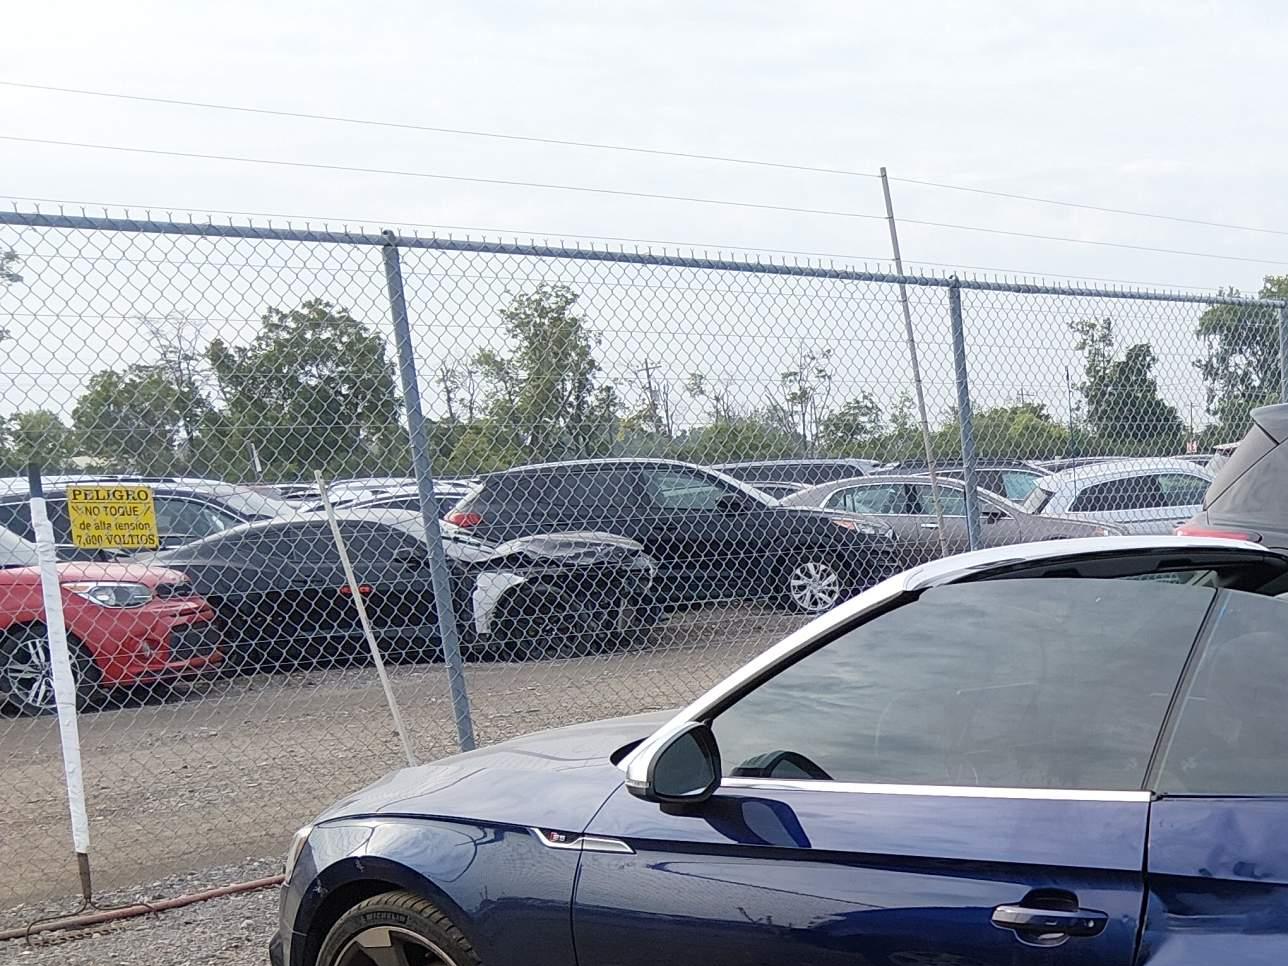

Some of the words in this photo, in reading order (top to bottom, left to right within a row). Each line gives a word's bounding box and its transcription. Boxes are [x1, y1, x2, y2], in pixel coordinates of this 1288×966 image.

[72, 489, 149, 501] PELIGRO
[85, 506, 100, 516] NO
[104, 506, 139, 516] TOQUE
[79, 520, 92, 530] de
[95, 521, 112, 531] alta
[76, 535, 103, 546] 7,000
[104, 534, 156, 545] VOLTIOS
